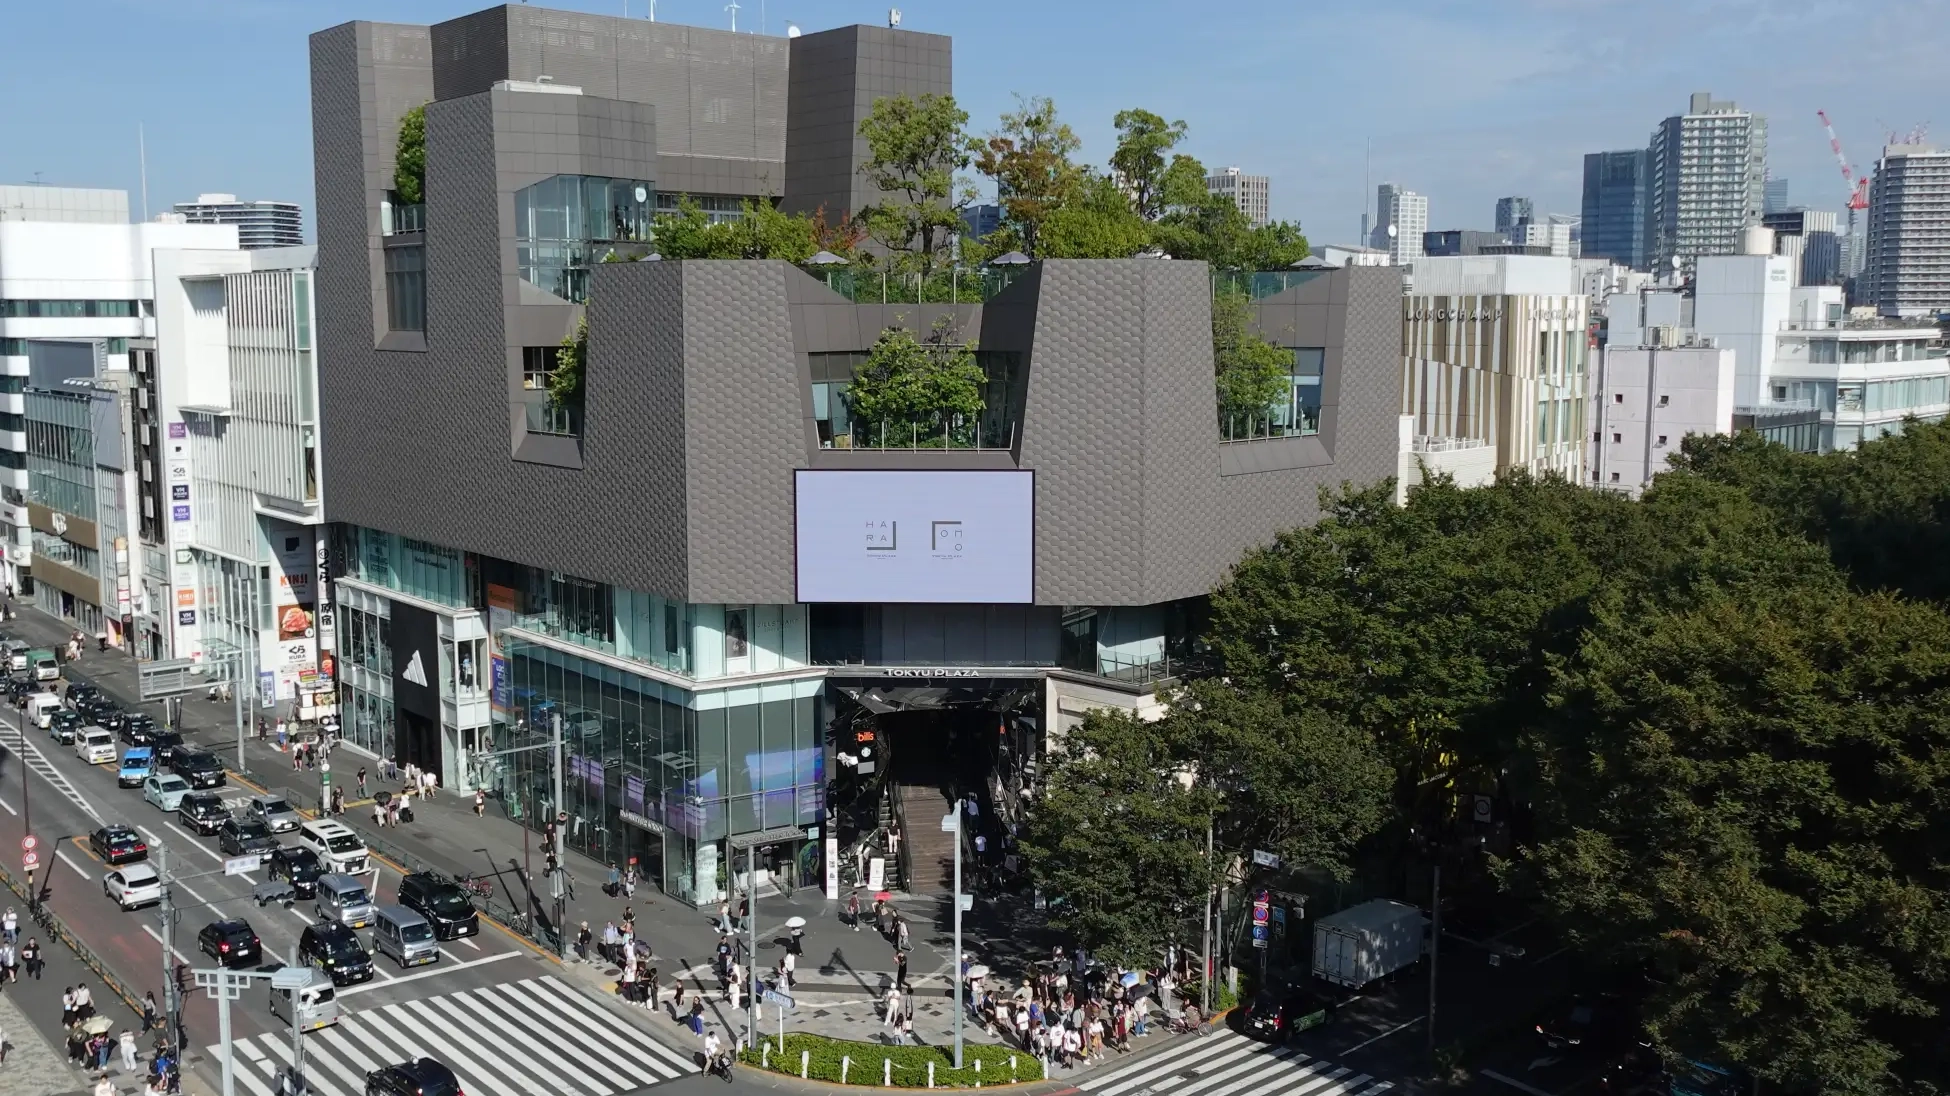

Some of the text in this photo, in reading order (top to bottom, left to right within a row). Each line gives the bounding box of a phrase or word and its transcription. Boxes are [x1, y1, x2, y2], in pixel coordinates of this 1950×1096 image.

[1406, 308, 1503, 321] LONGCHAMP
[1528, 308, 1581, 321] LONGCHAMP
[280, 573, 308, 586] KINJI
[321, 602, 332, 625] 原宿
[288, 645, 306, 654] くら
[885, 668, 980, 677] TOKYU PLAZA
